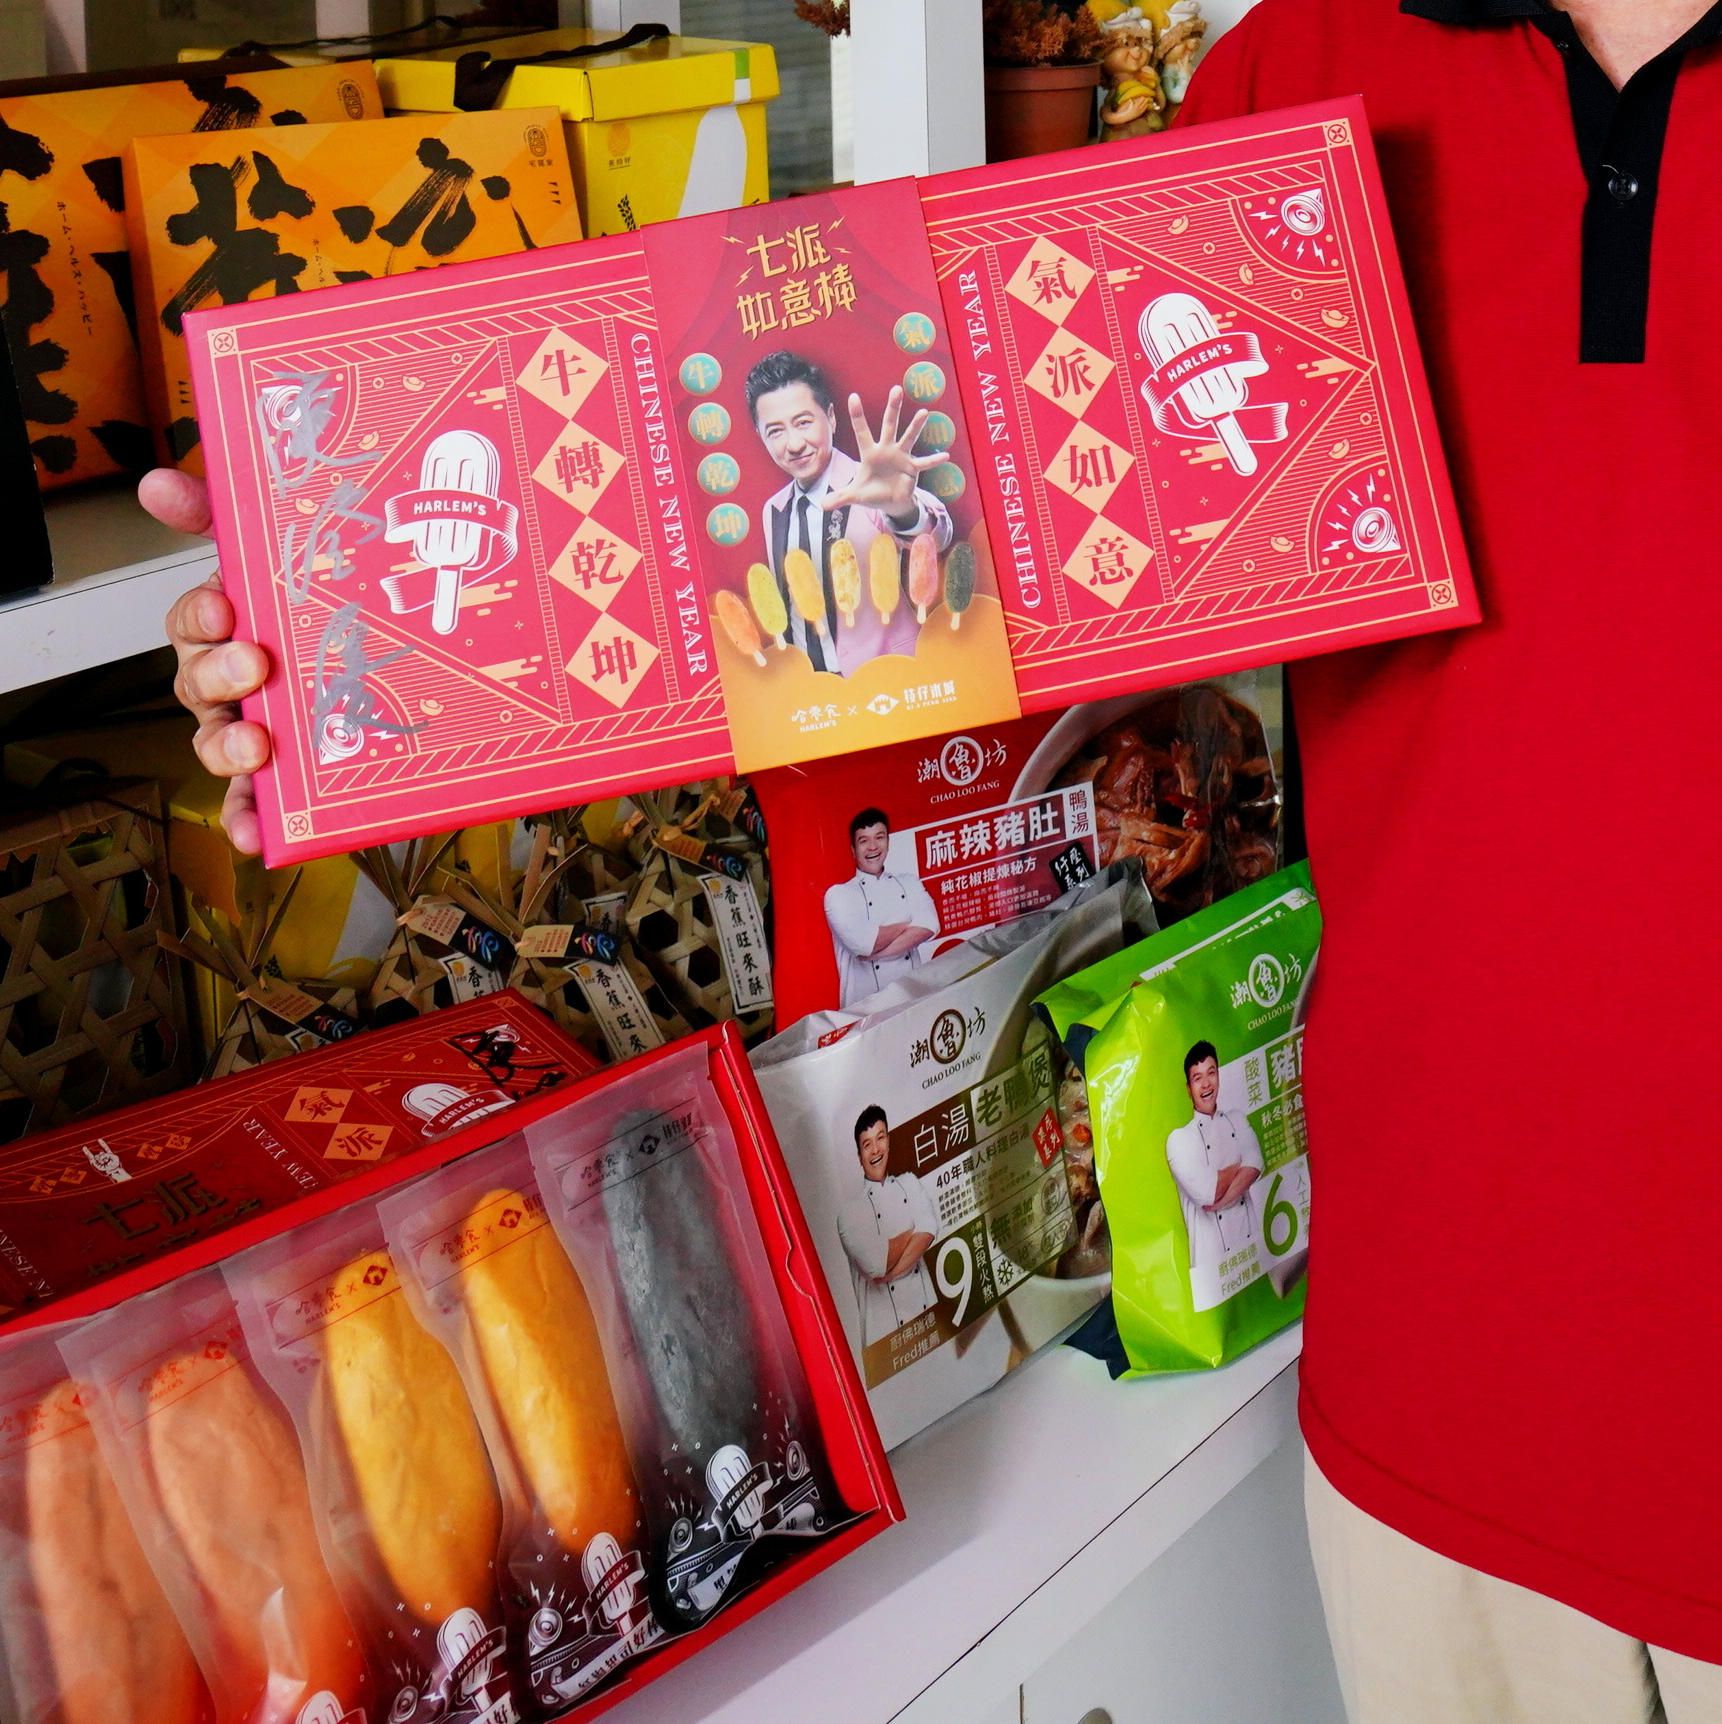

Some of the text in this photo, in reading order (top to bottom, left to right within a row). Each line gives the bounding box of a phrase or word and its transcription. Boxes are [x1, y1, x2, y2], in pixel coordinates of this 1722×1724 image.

[745, 222, 833, 279] 七派
[1166, 343, 1234, 382] HARLEM'S
[958, 269, 1043, 610] CHINESE NEW YEAR
[1028, 256, 1134, 586] 氣派如意
[687, 360, 743, 538] 牛轉乾坤
[413, 498, 489, 518] HARLEM'S
[538, 347, 640, 686] 牛轉乾坤
[630, 333, 709, 677] CHINESE NEW YEAR
[904, 680, 956, 704] 枝仔冰城
[791, 704, 842, 724] 哈零食
[799, 720, 837, 733] HARLEM'S
[930, 780, 1000, 804] CHAO LOO FANG
[1069, 790, 1089, 834] 鴨湯
[926, 802, 1061, 870] 麻辣豬肚
[941, 856, 1037, 895] 純花椒提煉秘方
[723, 884, 764, 998] 香蕉旺來酥
[1247, 1011, 1267, 1031] CHAO
[1267, 1004, 1283, 1024] LOO
[922, 1052, 981, 1090] CHAO LOO FANG
[976, 1051, 1051, 1127] 老鴨煲
[1245, 1056, 1262, 1107] 酸菜
[439, 1095, 486, 1126] HARLEM'S
[245, 1118, 290, 1160] YEAR
[914, 1104, 970, 1168] 白湯
[936, 1121, 1029, 1187] 40年職人料理白湯
[1263, 1173, 1299, 1257] 6
[935, 1237, 972, 1327] 9
[892, 1329, 941, 1371] Fred推薦
[726, 1471, 759, 1509] HARLEM'S
[596, 1562, 629, 1601] HARLEM'S
[457, 1639, 495, 1678] HARLEM'S
